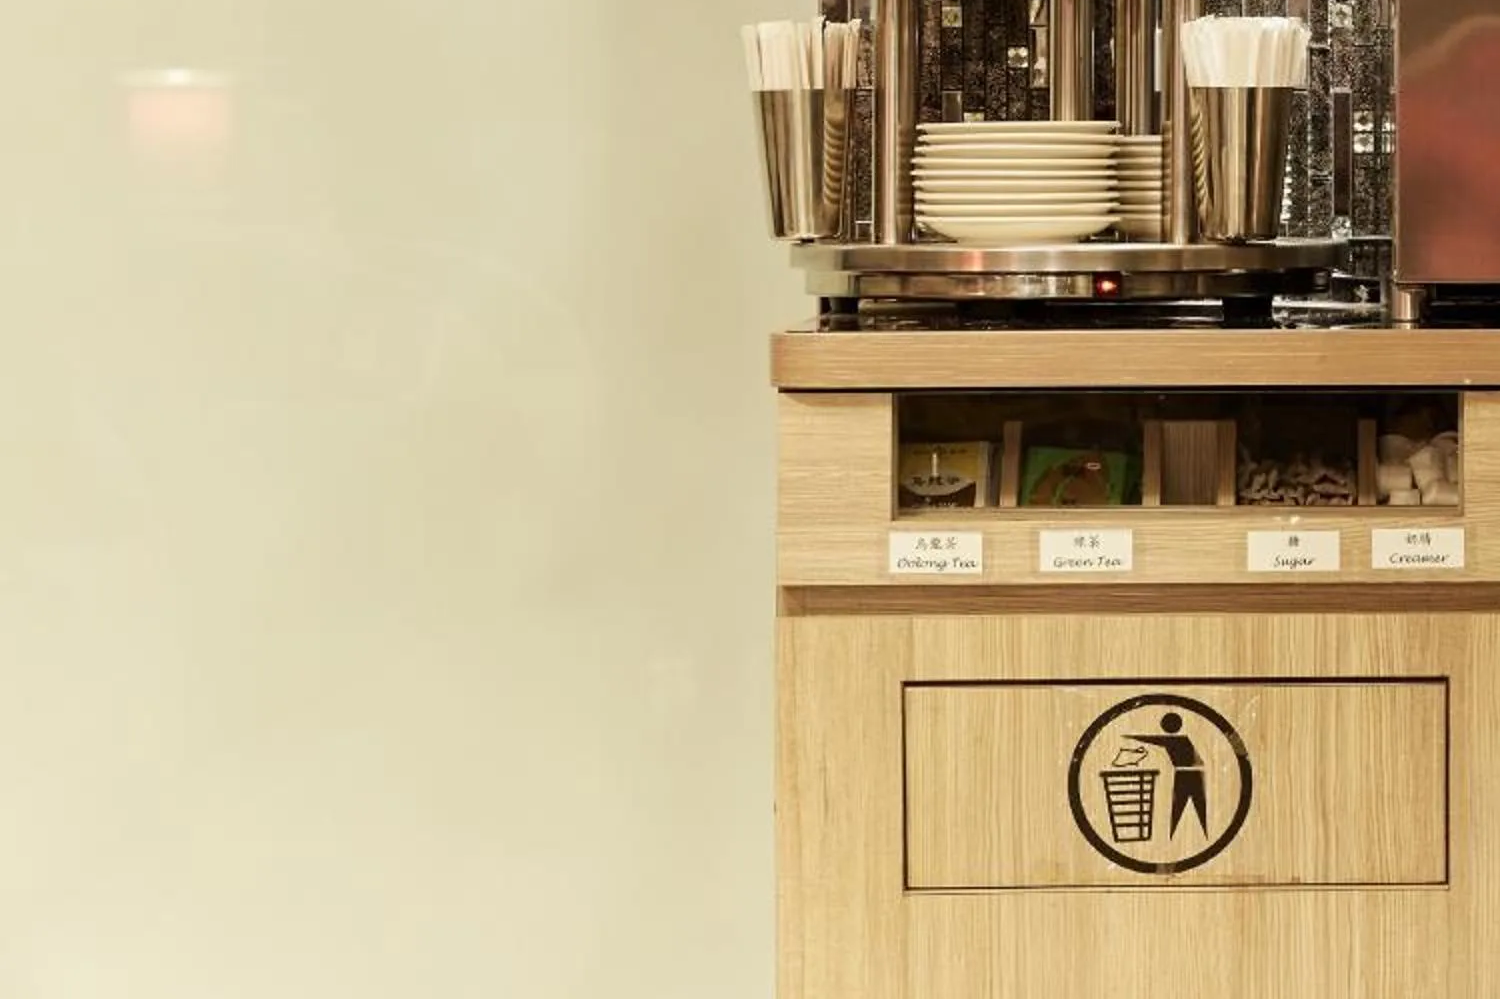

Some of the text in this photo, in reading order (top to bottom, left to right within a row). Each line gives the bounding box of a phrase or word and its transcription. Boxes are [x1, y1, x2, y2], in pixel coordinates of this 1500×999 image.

[897, 556, 977, 572] Oolong Tea
[1053, 555, 1122, 569] Green Tea
[1273, 555, 1316, 569] Sugar
[1388, 552, 1450, 565] Creamer
